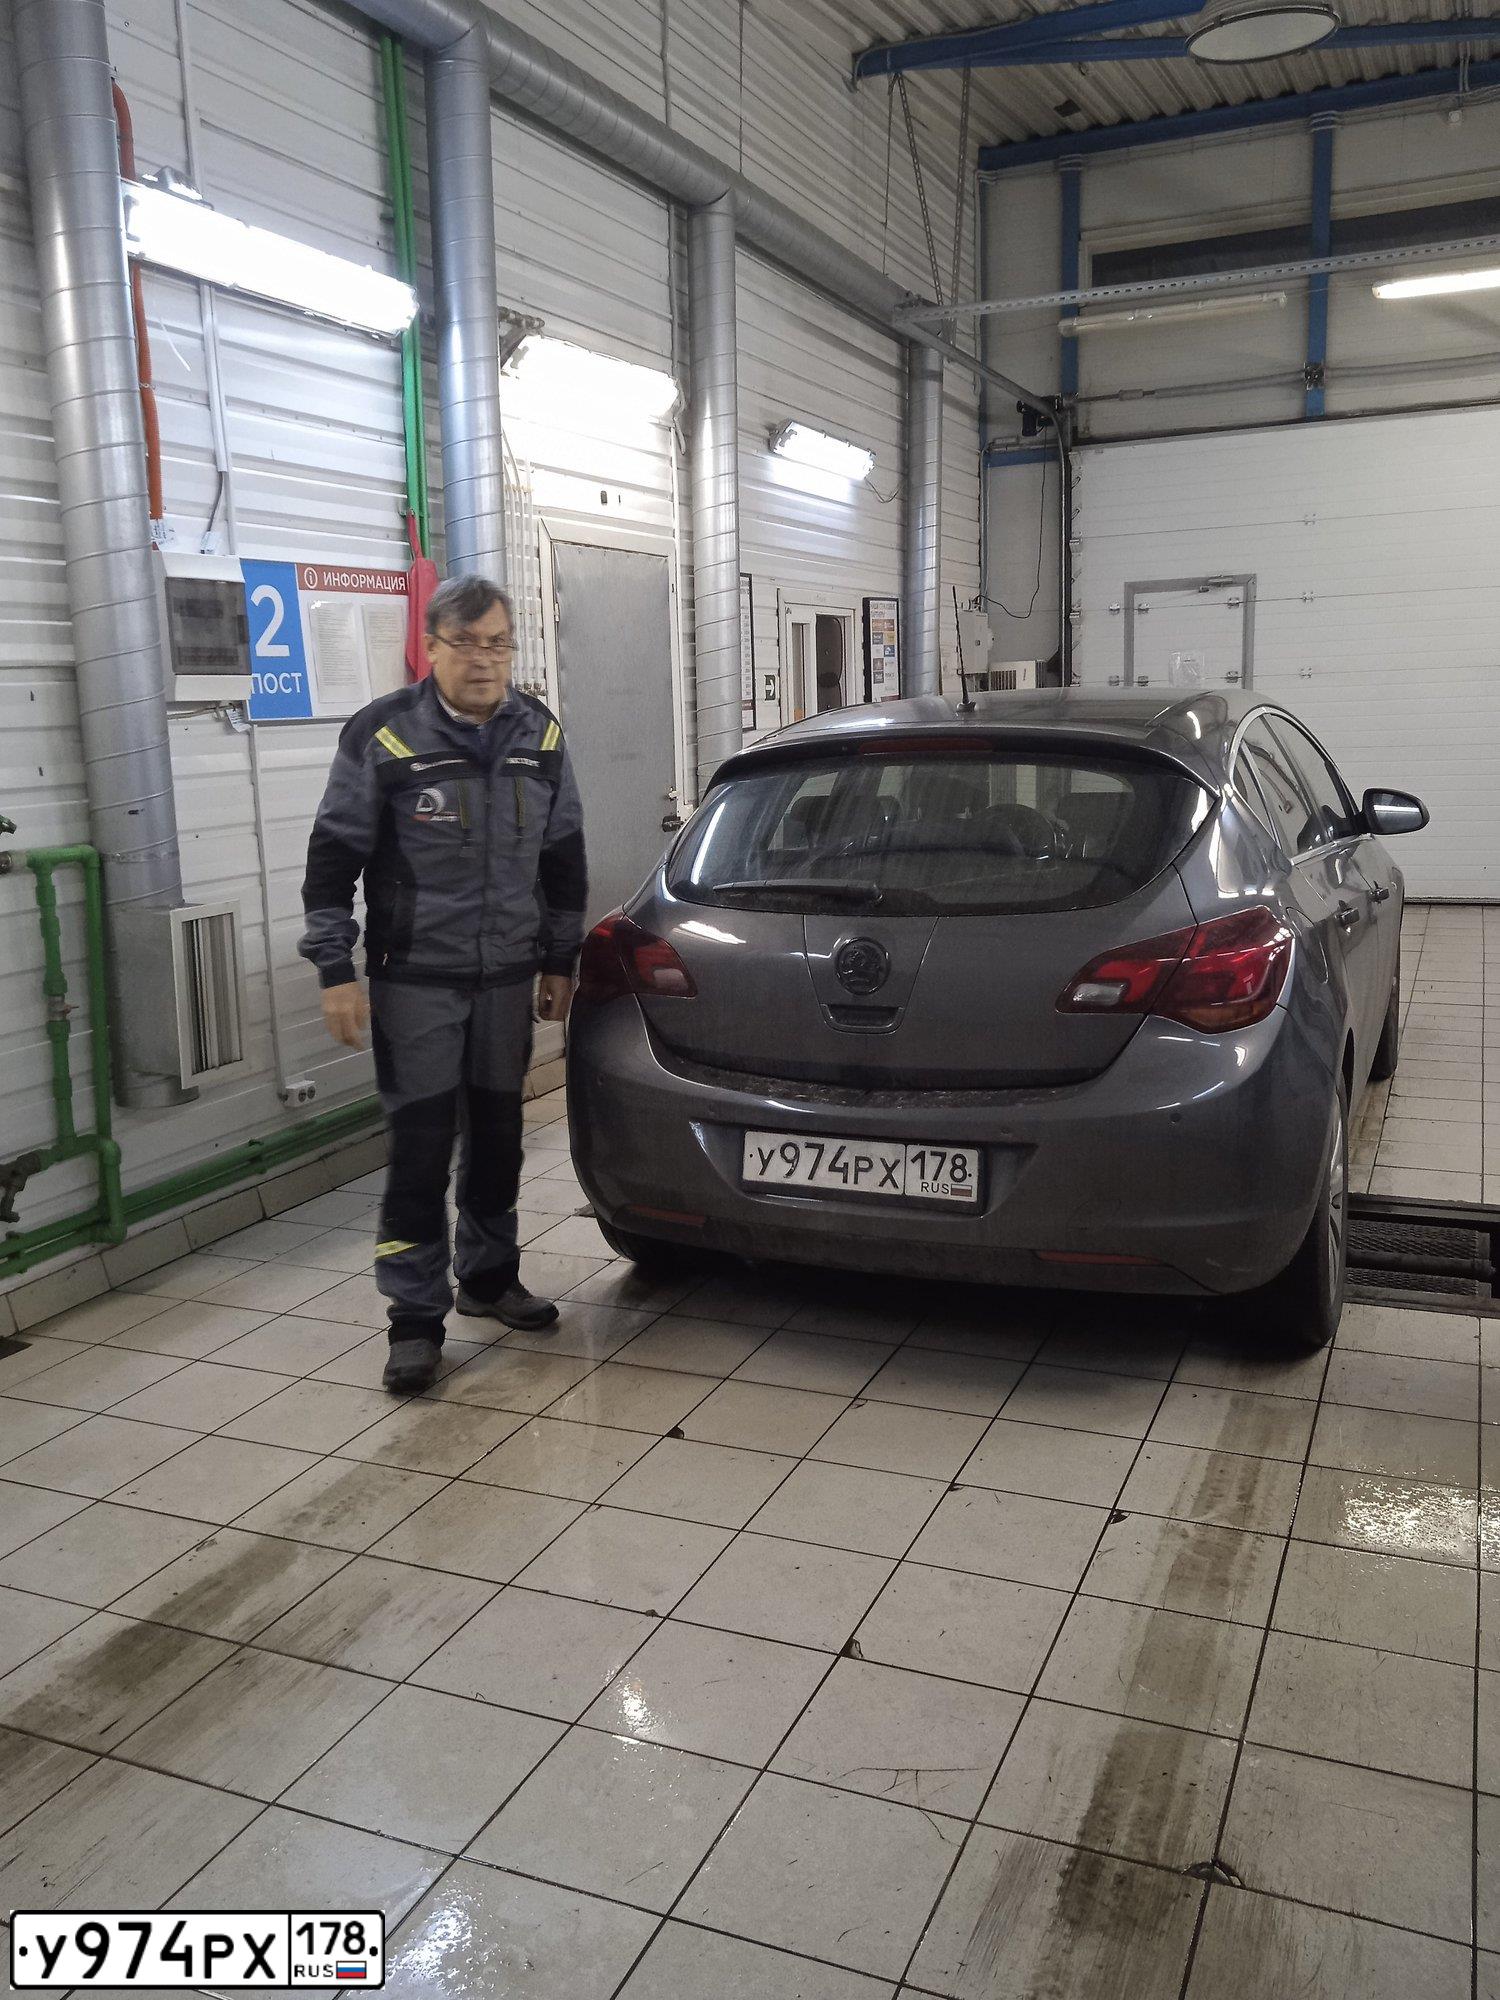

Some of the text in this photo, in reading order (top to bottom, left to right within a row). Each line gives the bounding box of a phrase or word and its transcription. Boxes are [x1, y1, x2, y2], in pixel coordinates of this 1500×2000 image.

[323, 571, 406, 592] ИНФОРМАЦИЯ
[250, 584, 290, 657] 2
[251, 672, 302, 695] ПОСТ
[910, 1150, 968, 1183] 178
[920, 1181, 950, 1195] RUS
